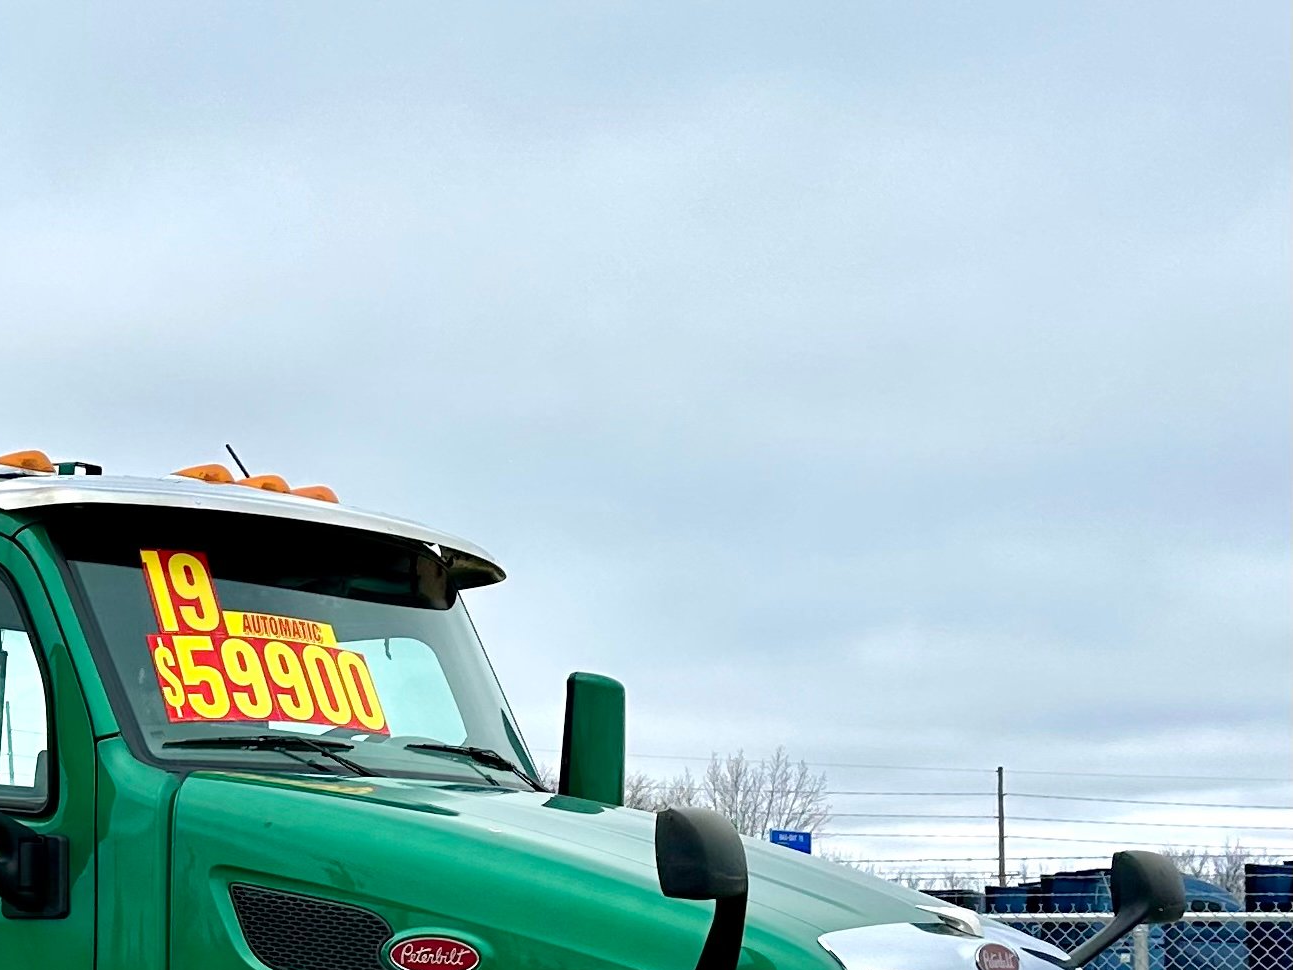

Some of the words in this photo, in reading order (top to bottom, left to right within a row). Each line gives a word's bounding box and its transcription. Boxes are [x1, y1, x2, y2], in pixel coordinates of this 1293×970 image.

[140, 550, 220, 632] 19
[242, 613, 323, 644] AUTOMATIC
[154, 635, 386, 731] $59900
[400, 943, 471, 966] Peterbilt
